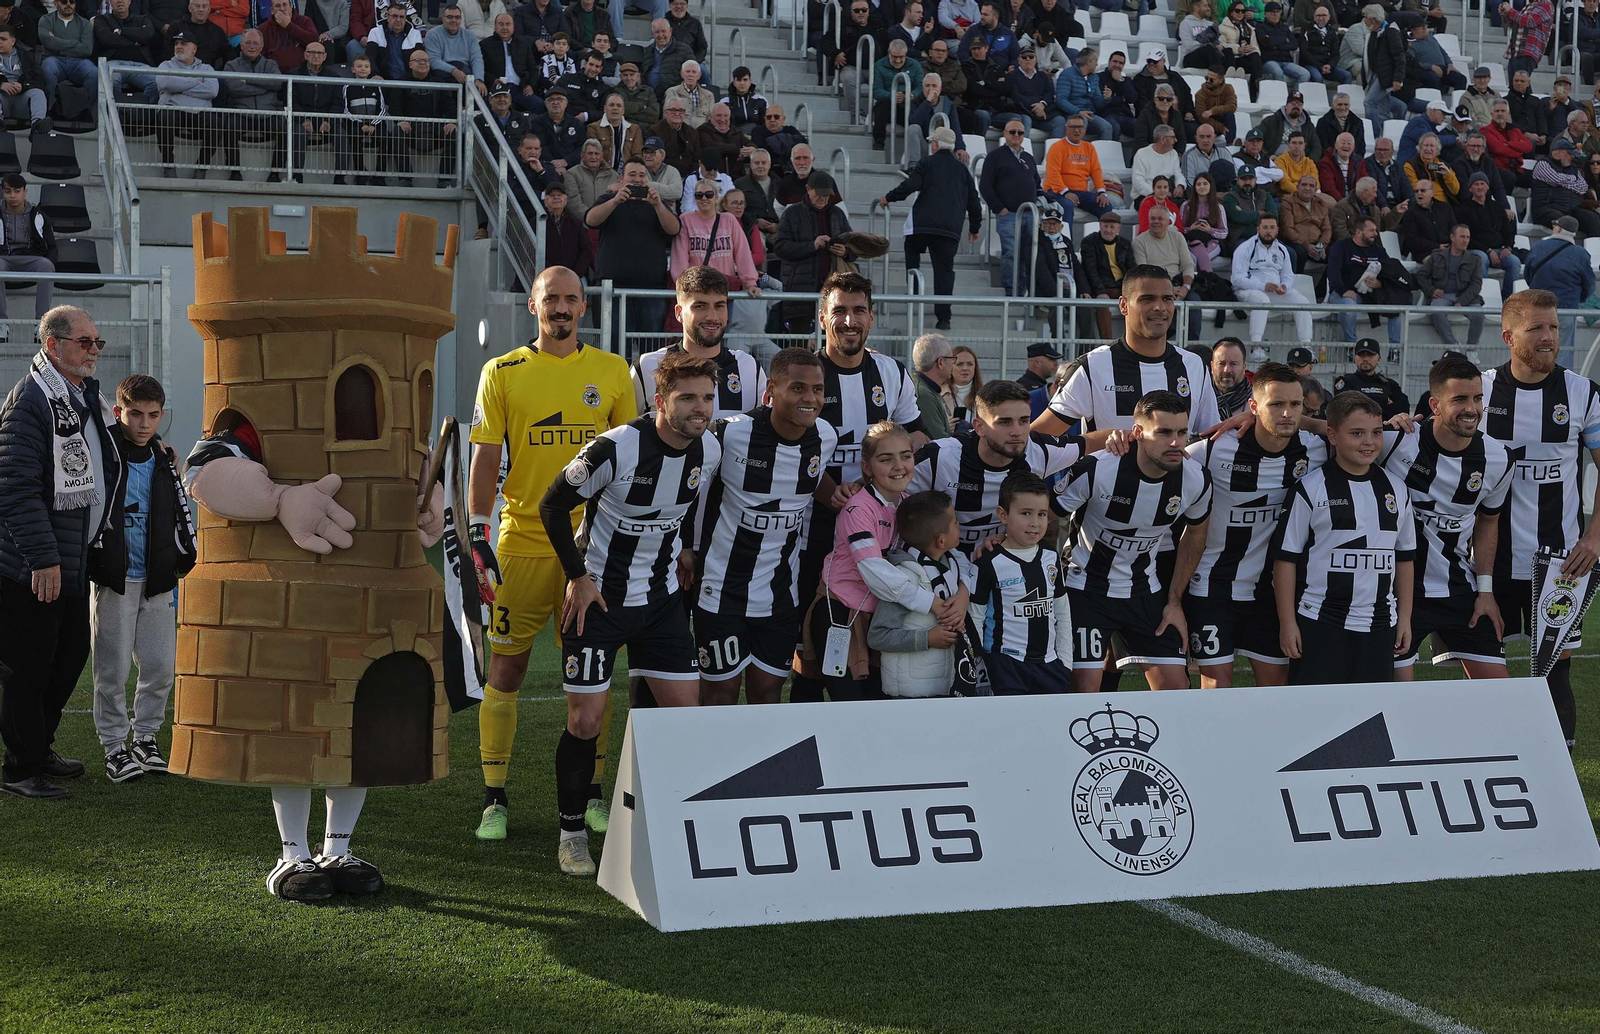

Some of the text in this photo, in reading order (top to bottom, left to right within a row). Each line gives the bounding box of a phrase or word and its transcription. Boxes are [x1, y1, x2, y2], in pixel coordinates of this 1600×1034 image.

[689, 236, 732, 252] BROLYN
[496, 357, 527, 370] LEGEA
[1104, 384, 1135, 393] LEGEA
[1483, 406, 1508, 416] EGEA
[735, 455, 768, 469] LEGEA
[1220, 462, 1252, 473] LEGEA
[620, 474, 654, 485] LEGEA
[1517, 463, 1562, 481] TUS
[946, 481, 979, 492] LEGEA
[1099, 493, 1132, 505] LEGEA
[1317, 498, 1349, 508] LEGEA
[740, 510, 806, 531] LOTUS
[1076, 627, 1103, 659] 16
[1202, 624, 1221, 656] 3
[709, 635, 740, 670] 10
[581, 647, 605, 682] 11
[1075, 756, 1187, 826] REAL BALOMPEDICA
[1280, 776, 1538, 843] LOTUS
[684, 804, 983, 879] LOTUS
[1114, 847, 1179, 871] LINENSE
